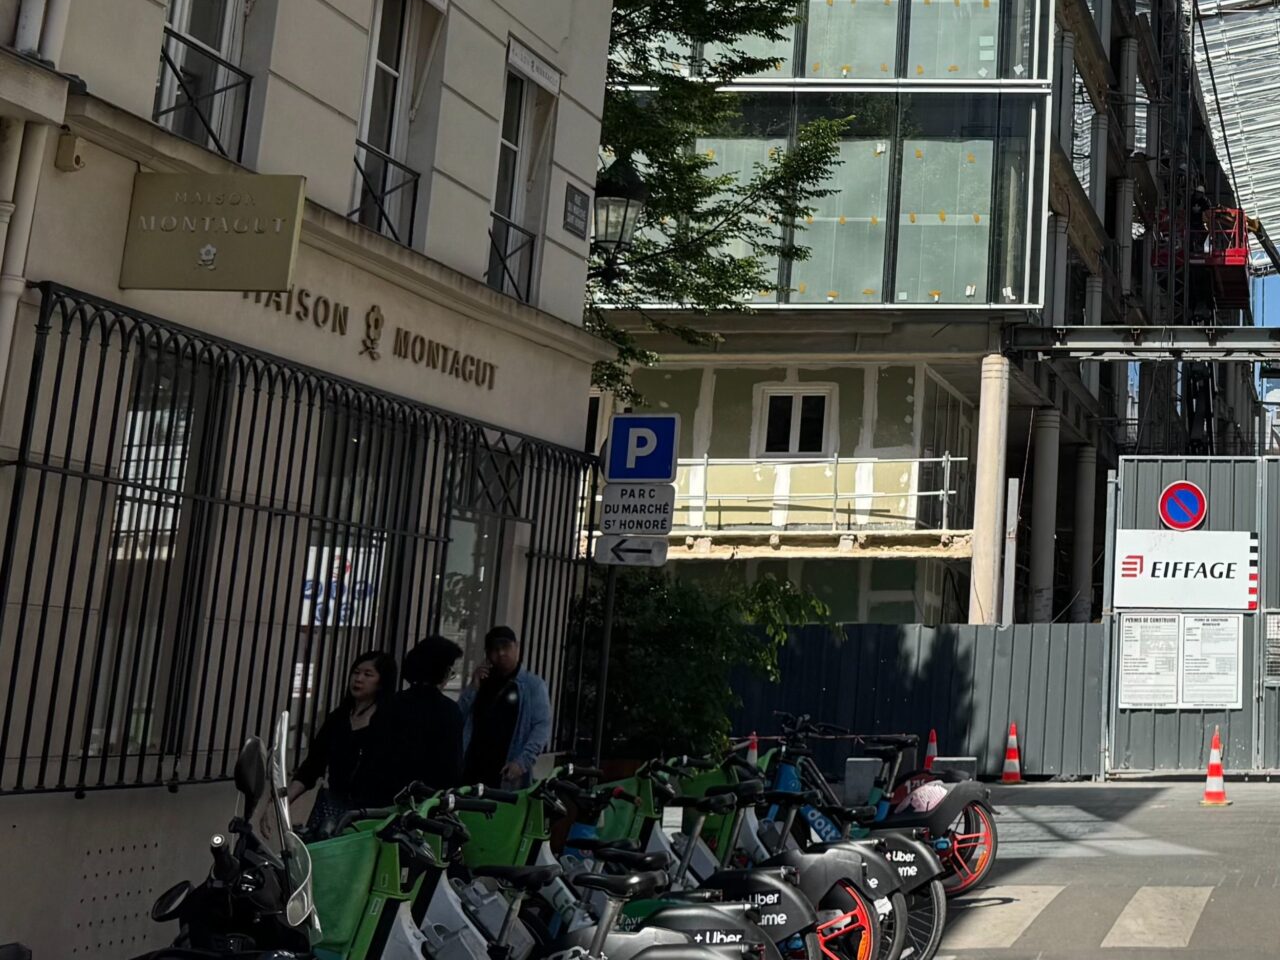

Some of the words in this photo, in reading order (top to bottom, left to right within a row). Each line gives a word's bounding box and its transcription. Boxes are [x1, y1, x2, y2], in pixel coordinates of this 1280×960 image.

[174, 191, 256, 207] MAISON
[139, 215, 287, 234] MONTAGUT
[393, 326, 499, 391] MONTAGUT
[626, 427, 658, 469] P
[620, 489, 656, 499] PARC
[604, 504, 619, 514] DU
[621, 501, 670, 514] MARCHÉ
[619, 517, 668, 530] HONORÉ
[1150, 561, 1238, 579] EIFFAGE
[892, 850, 916, 862] Uber
